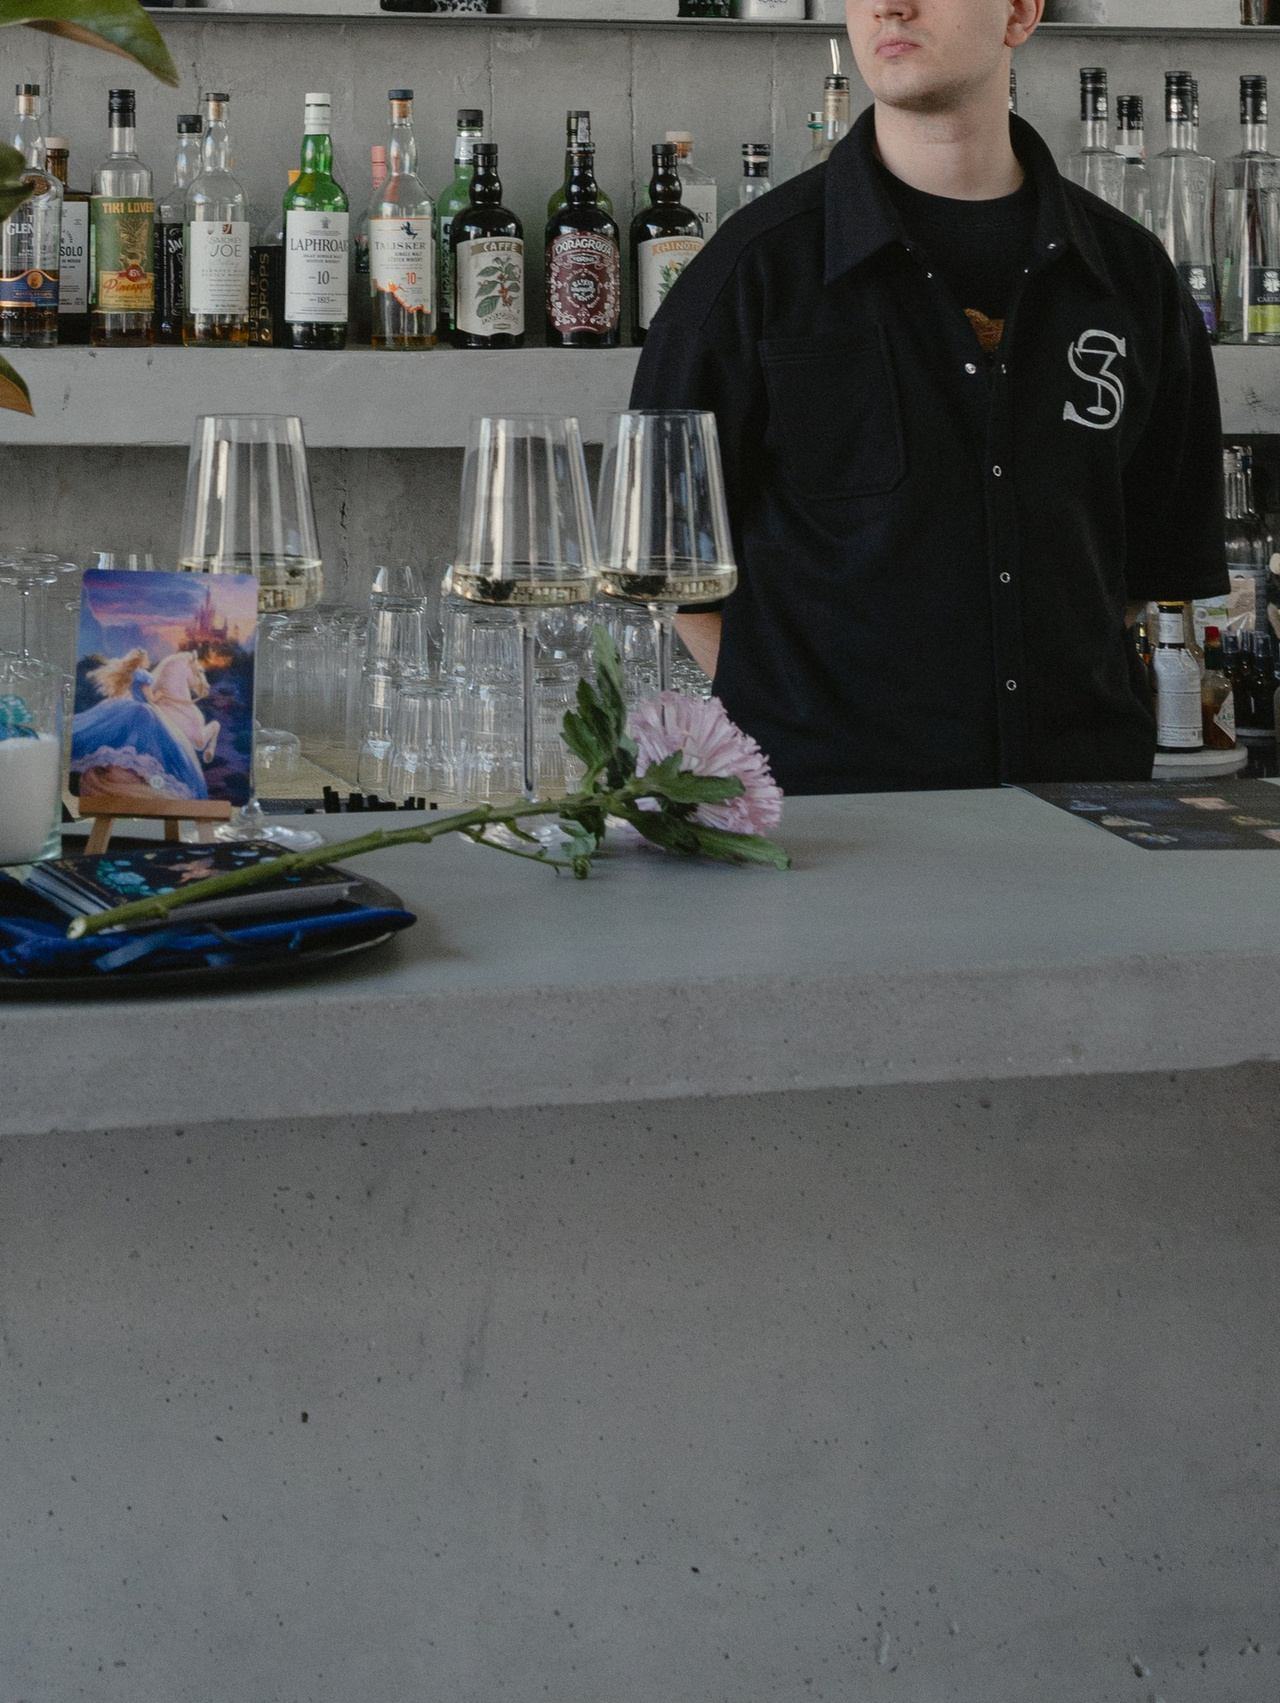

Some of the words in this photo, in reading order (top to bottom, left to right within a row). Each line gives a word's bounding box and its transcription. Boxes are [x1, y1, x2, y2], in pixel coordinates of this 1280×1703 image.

[103, 202, 124, 214] TIKI
[210, 244, 242, 257] JOE
[375, 241, 426, 251] TALISKER
[317, 271, 330, 285] 10
[406, 272, 416, 285] 10
[260, 253, 269, 319] DROPS
